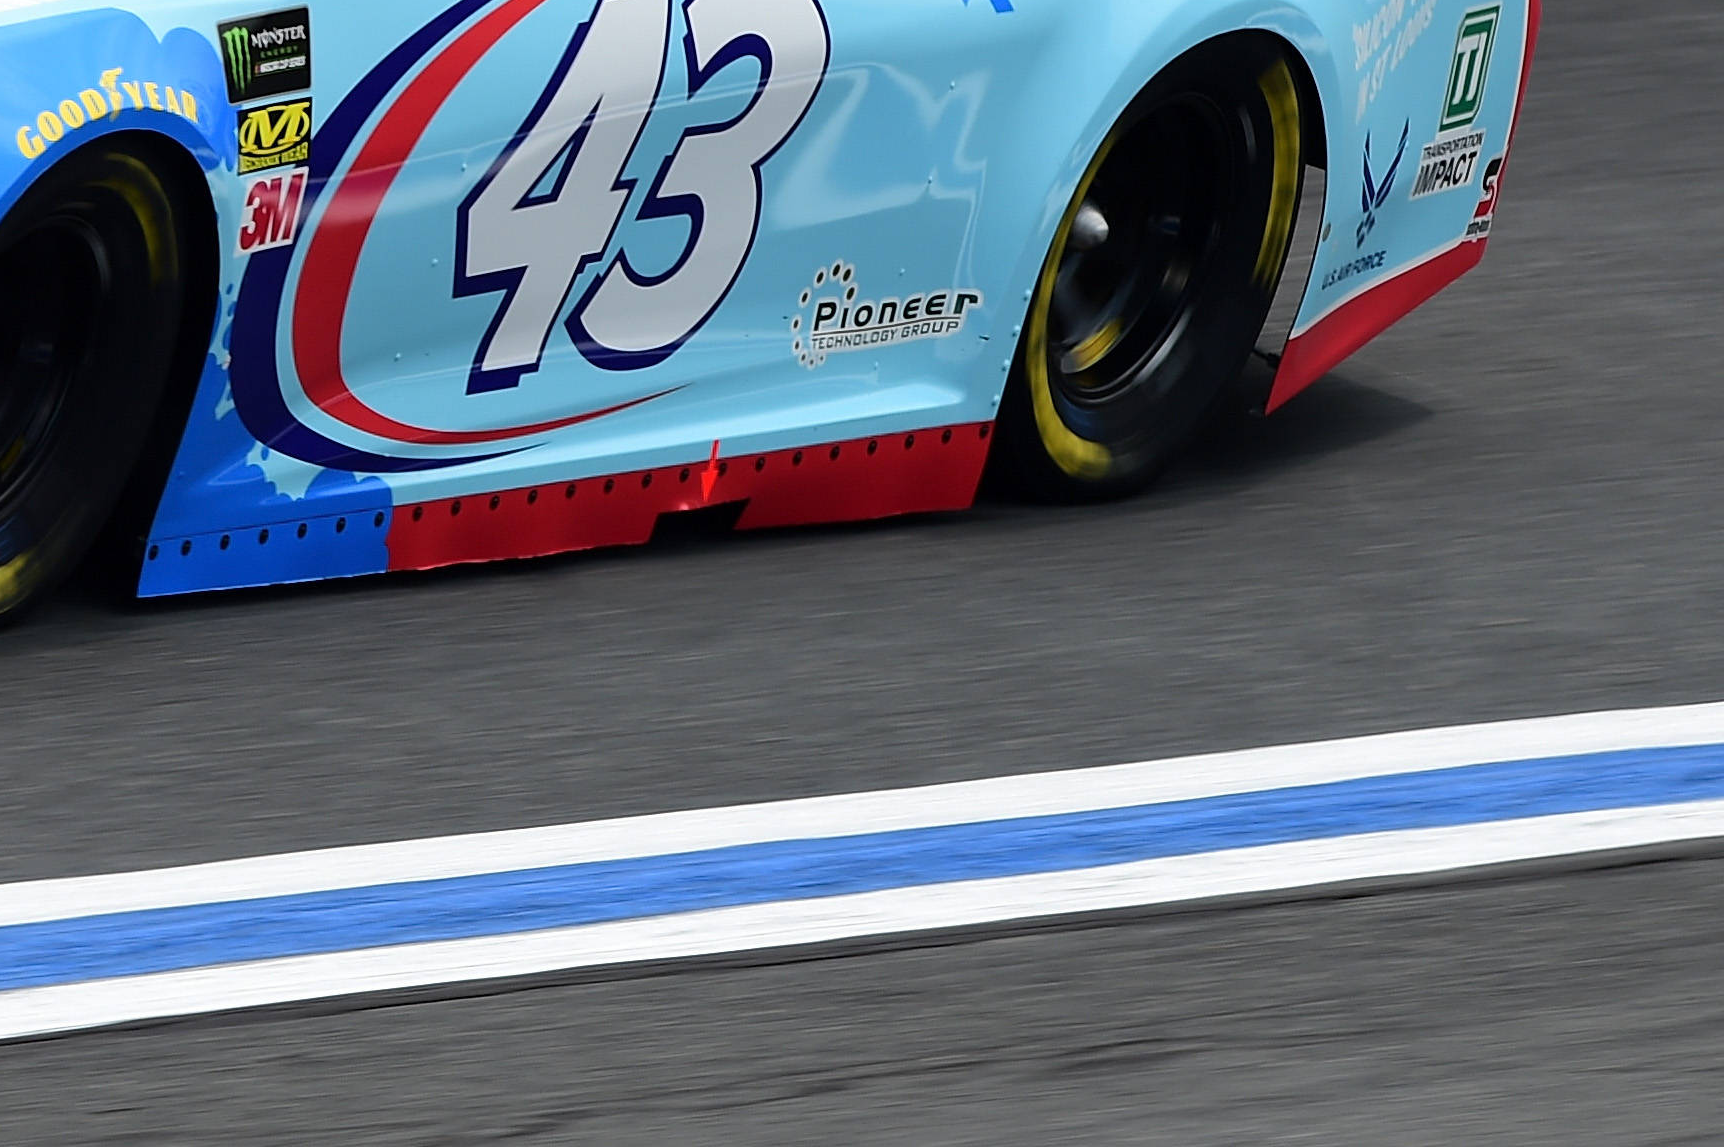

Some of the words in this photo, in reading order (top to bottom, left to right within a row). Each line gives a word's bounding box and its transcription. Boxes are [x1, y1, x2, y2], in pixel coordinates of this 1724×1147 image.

[1412, 151, 1478, 197] IMPACT
[240, 173, 305, 250] 3M
[1352, 249, 1387, 274] FORCE
[813, 293, 978, 332] Pioneer
[812, 328, 898, 350] TECHNOLOGY
[901, 321, 959, 339] GROUP
